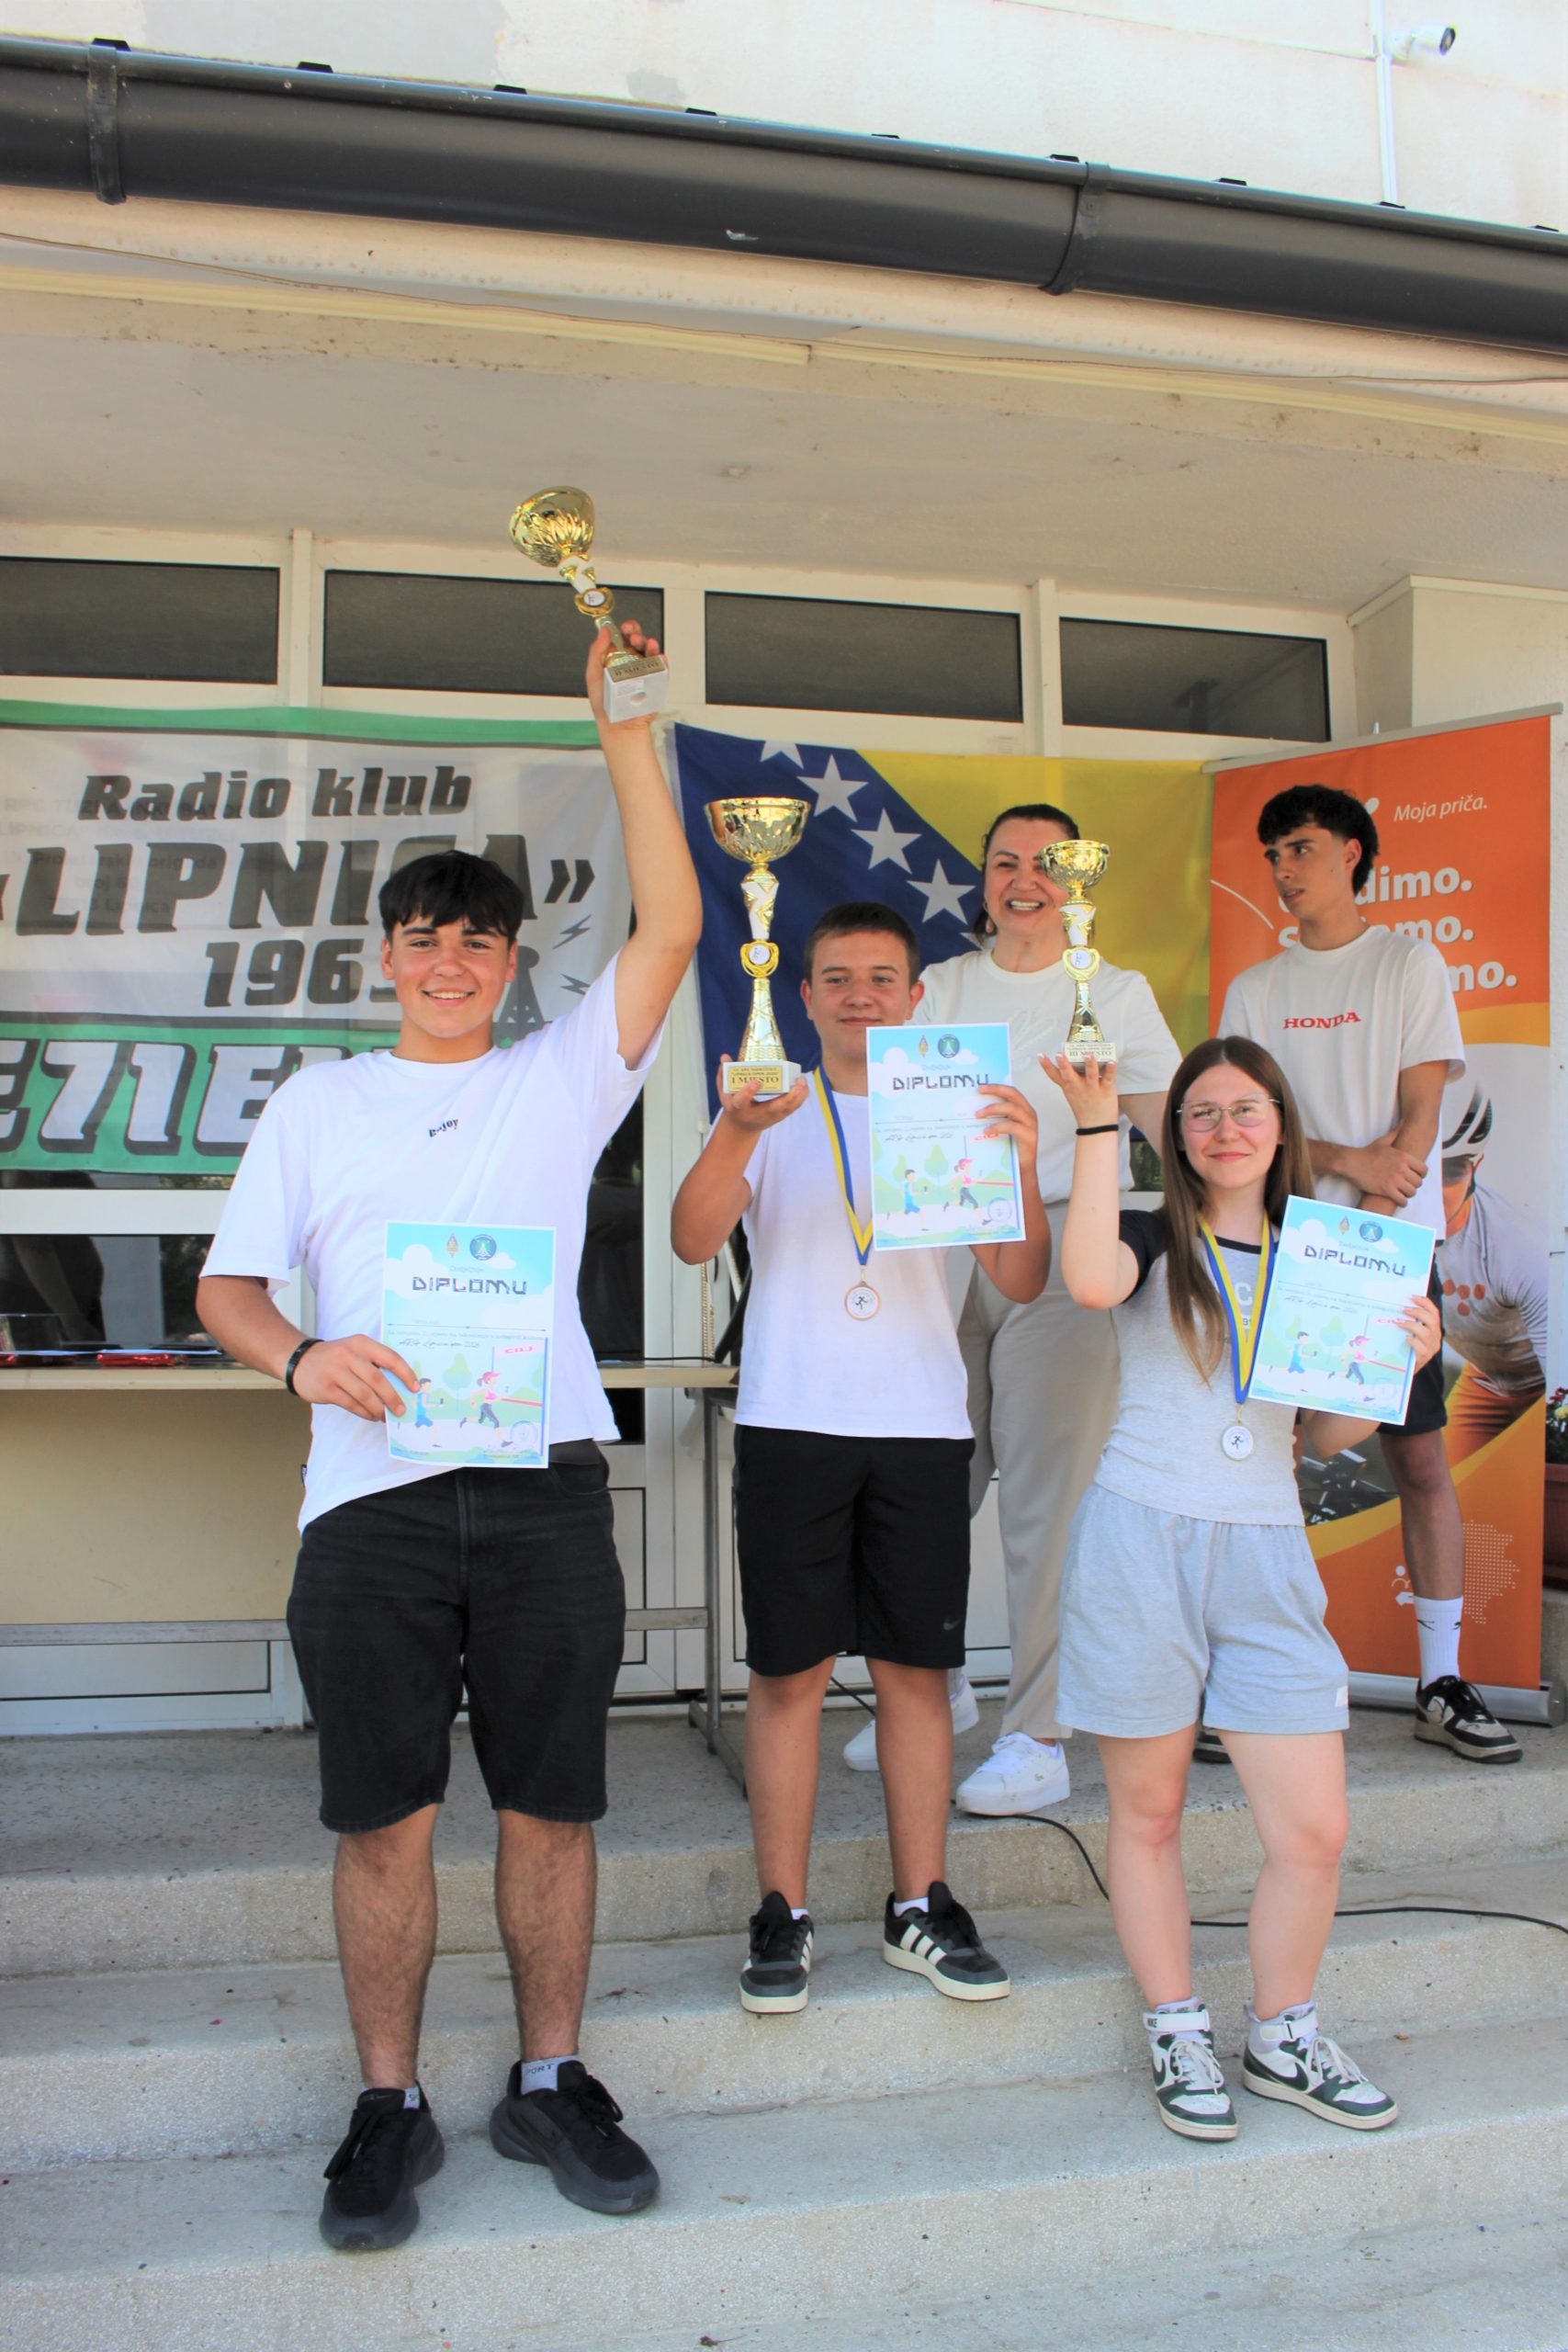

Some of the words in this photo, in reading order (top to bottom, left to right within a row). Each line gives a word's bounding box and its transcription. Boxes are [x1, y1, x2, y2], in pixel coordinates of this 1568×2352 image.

[78, 770, 291, 821] Radio
[311, 765, 472, 817] klub
[1393, 802, 1437, 823] Moja
[1439, 795, 1488, 820] priča.
[1282, 1011, 1361, 1030] HONDA
[892, 1073, 989, 1091] DIPLOMU
[1303, 1244, 1406, 1277] DIPLOMU
[412, 1275, 527, 1295] DIPLOMU
